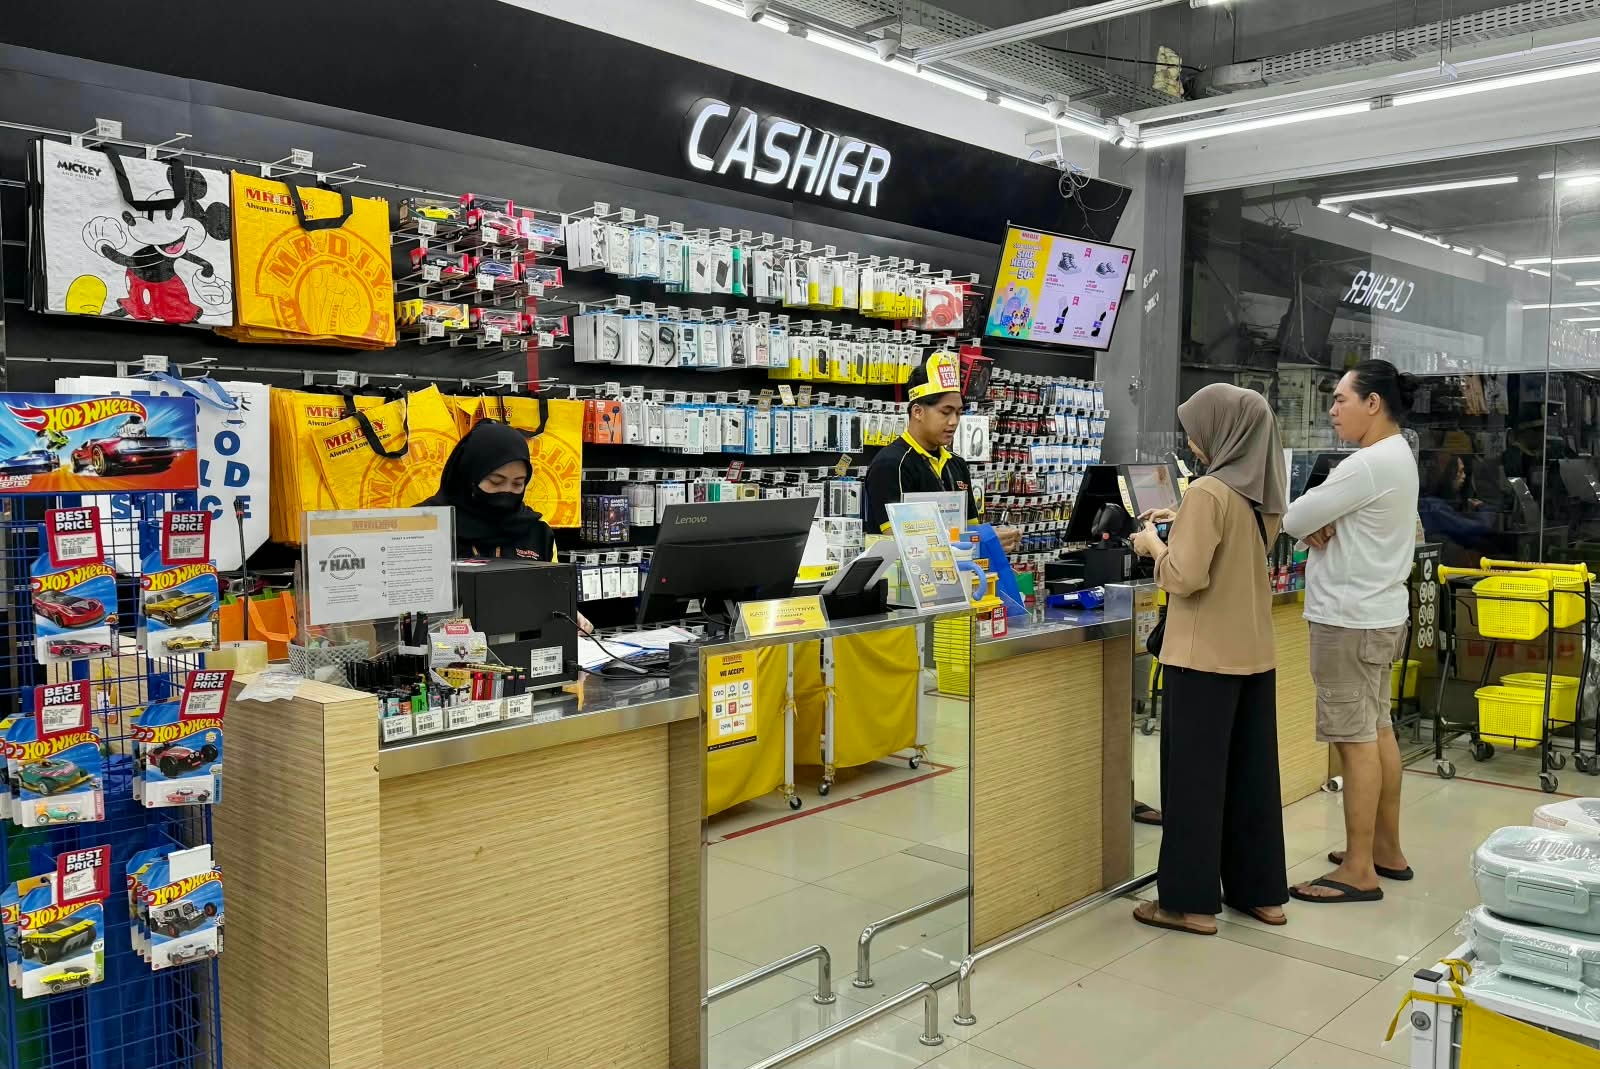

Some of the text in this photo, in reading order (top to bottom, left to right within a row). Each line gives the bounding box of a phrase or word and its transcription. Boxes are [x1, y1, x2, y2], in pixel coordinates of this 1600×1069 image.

[686, 98, 891, 207] CASHIER
[57, 160, 102, 176] MICKEY
[55, 510, 92, 522] BEST
[171, 513, 205, 523] BEST
[675, 515, 708, 525] Lenovo
[56, 520, 93, 532] PRICE
[170, 523, 204, 532] PRICE
[319, 557, 366, 572] 7 HARI
[195, 672, 227, 682] BEST
[728, 667, 745, 675] ACCEPT
[44, 683, 81, 698] BEST
[193, 680, 225, 689] PRICE
[44, 692, 81, 706] PRICE
[66, 849, 103, 863] BEST
[66, 857, 103, 873] PRICE
